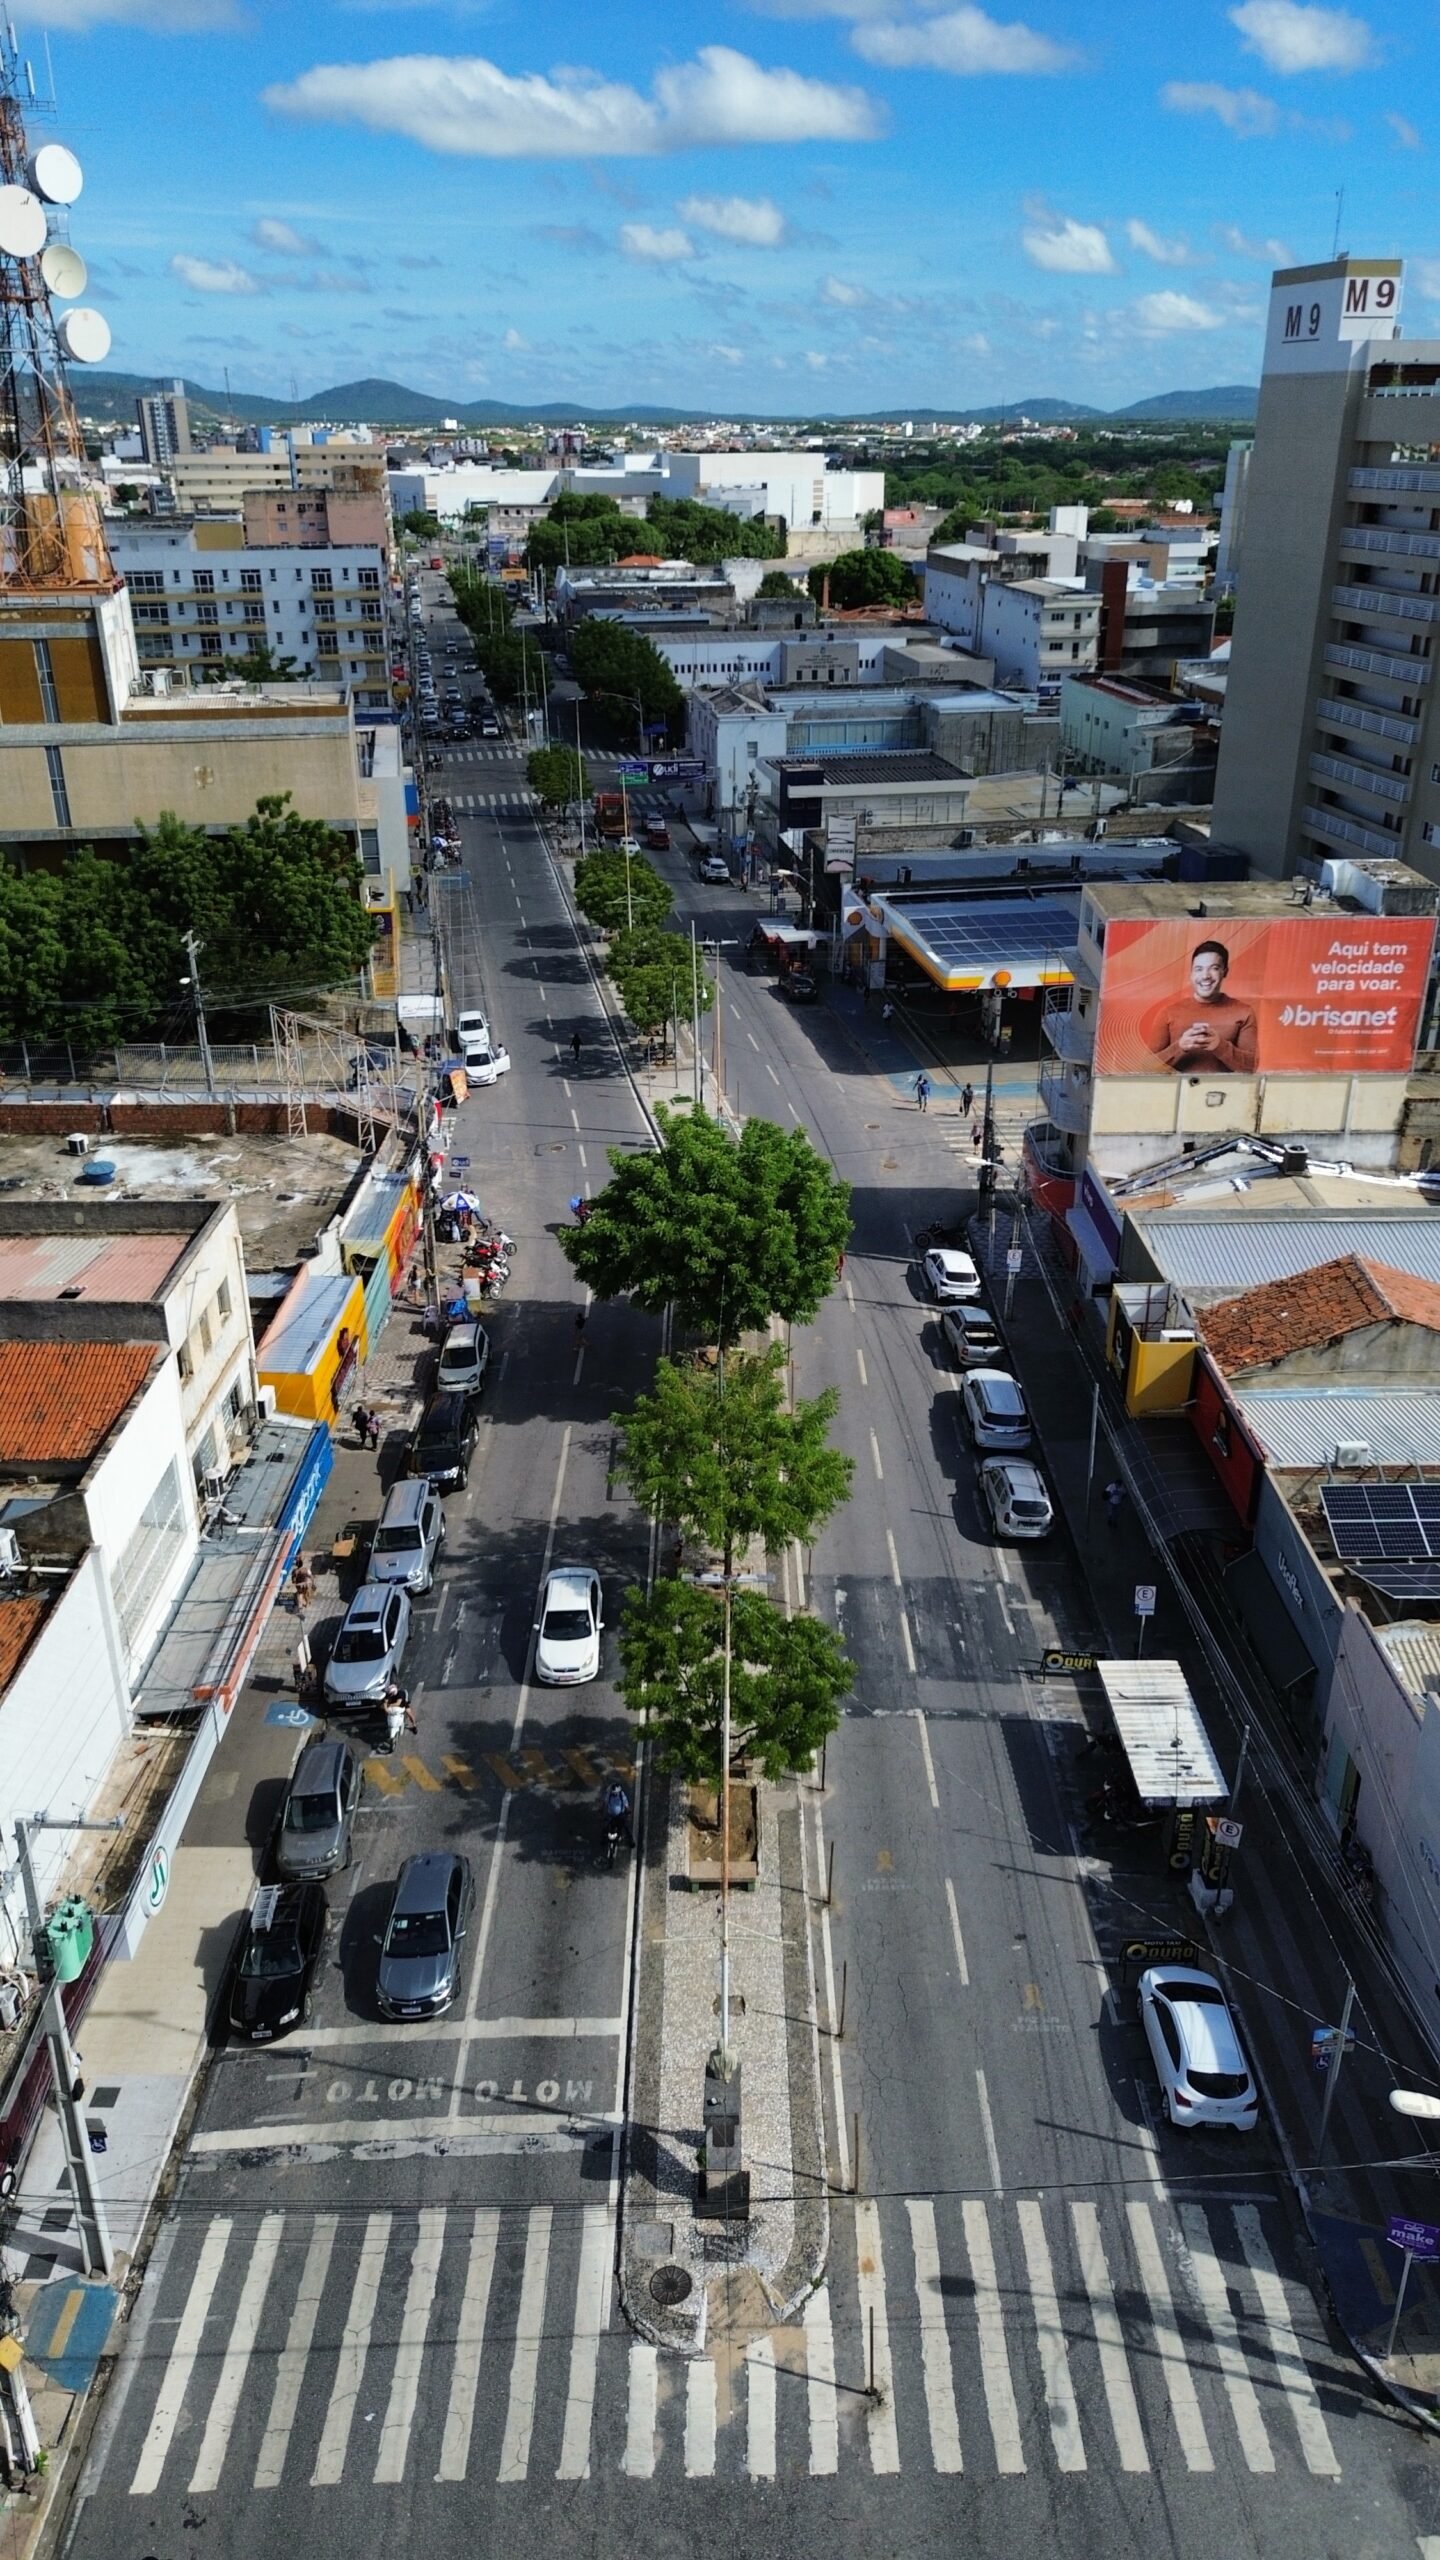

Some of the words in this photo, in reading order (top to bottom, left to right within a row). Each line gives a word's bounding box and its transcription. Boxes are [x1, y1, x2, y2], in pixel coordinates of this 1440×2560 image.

[1328, 941, 1370, 959] Aqui
[1373, 942, 1408, 955] tem
[1311, 959, 1405, 975] velocidade
[1316, 979, 1355, 994] para
[1360, 979, 1401, 991] voar.
[1294, 1004, 1398, 1026] brisanet
[326, 2077, 445, 2102] MOTO
[475, 2079, 593, 2102] MOTO
[1391, 2229, 1435, 2245] make
